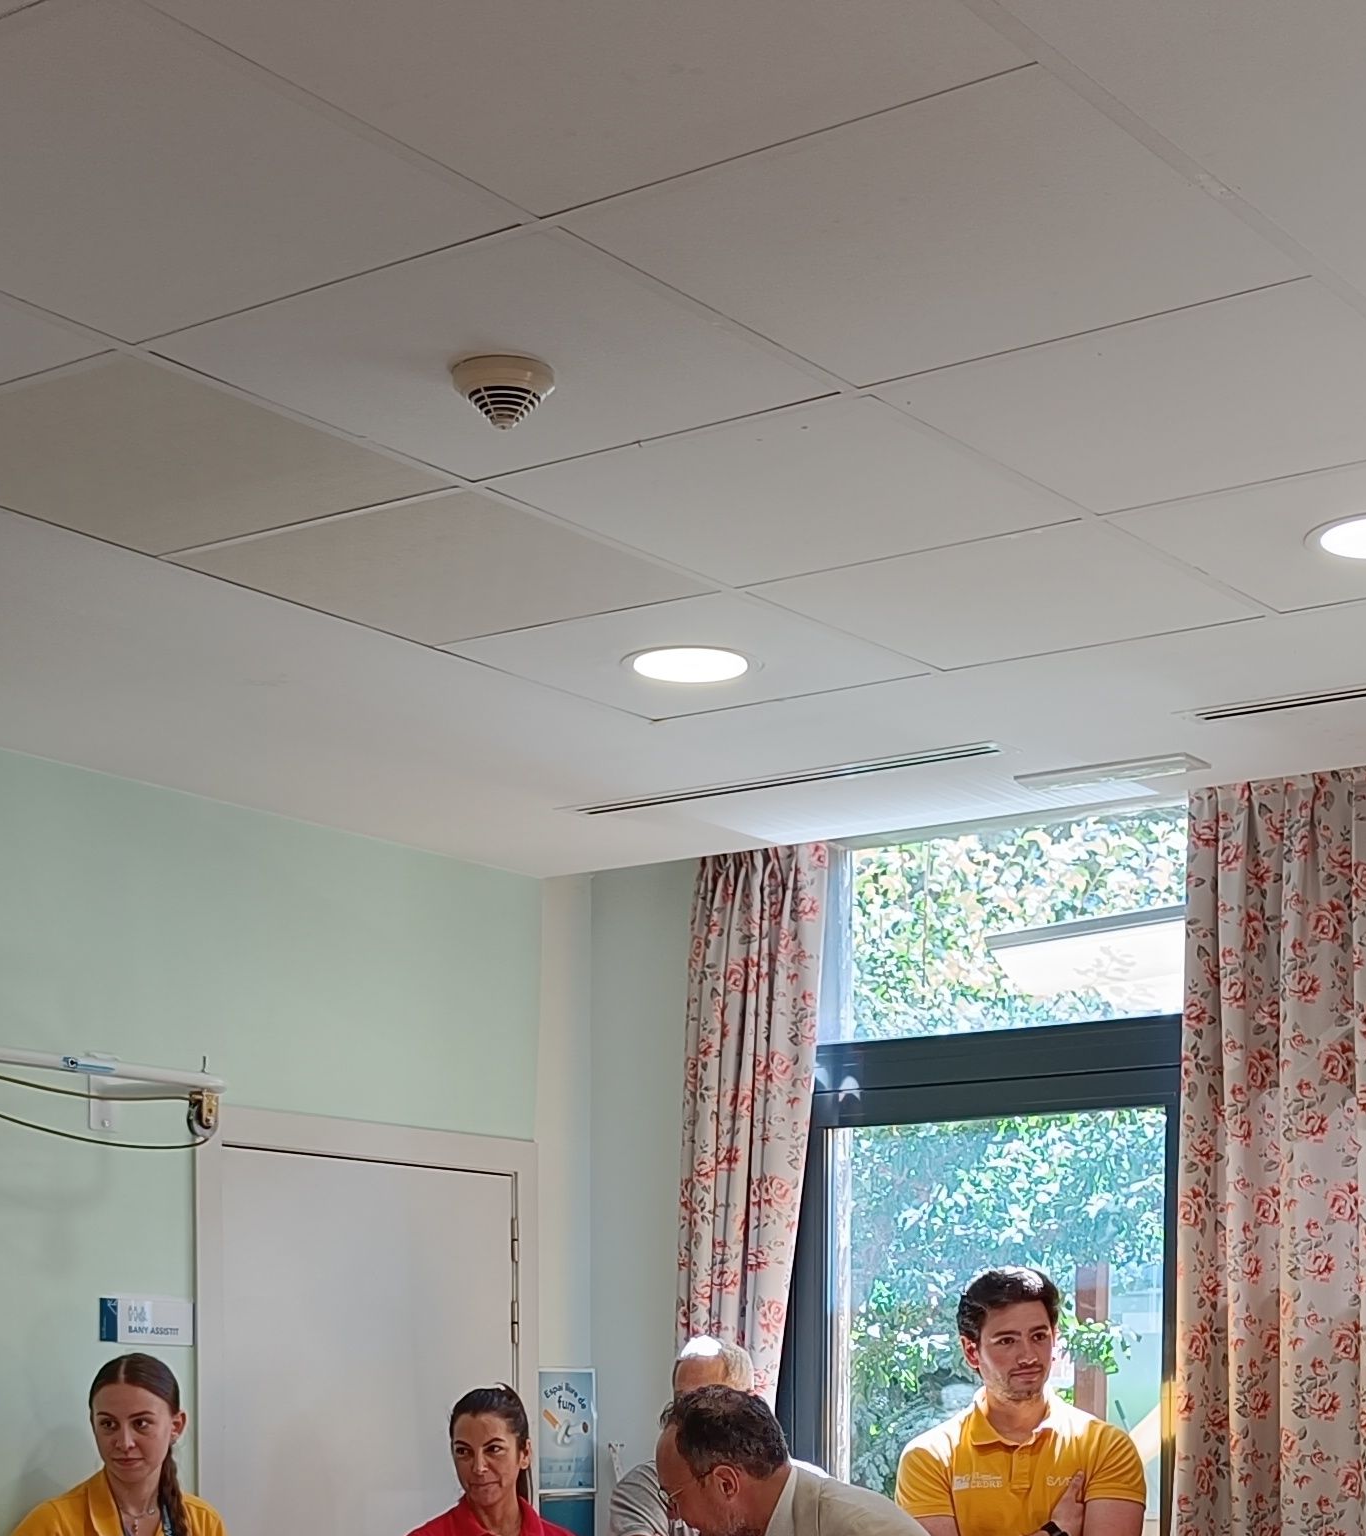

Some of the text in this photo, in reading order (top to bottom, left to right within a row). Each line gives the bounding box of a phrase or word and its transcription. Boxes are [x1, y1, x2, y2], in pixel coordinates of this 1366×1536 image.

[128, 1325, 148, 1334] BANY
[543, 1382, 565, 1399] Espai
[578, 1395, 588, 1410] de
[557, 1395, 577, 1414] fum
